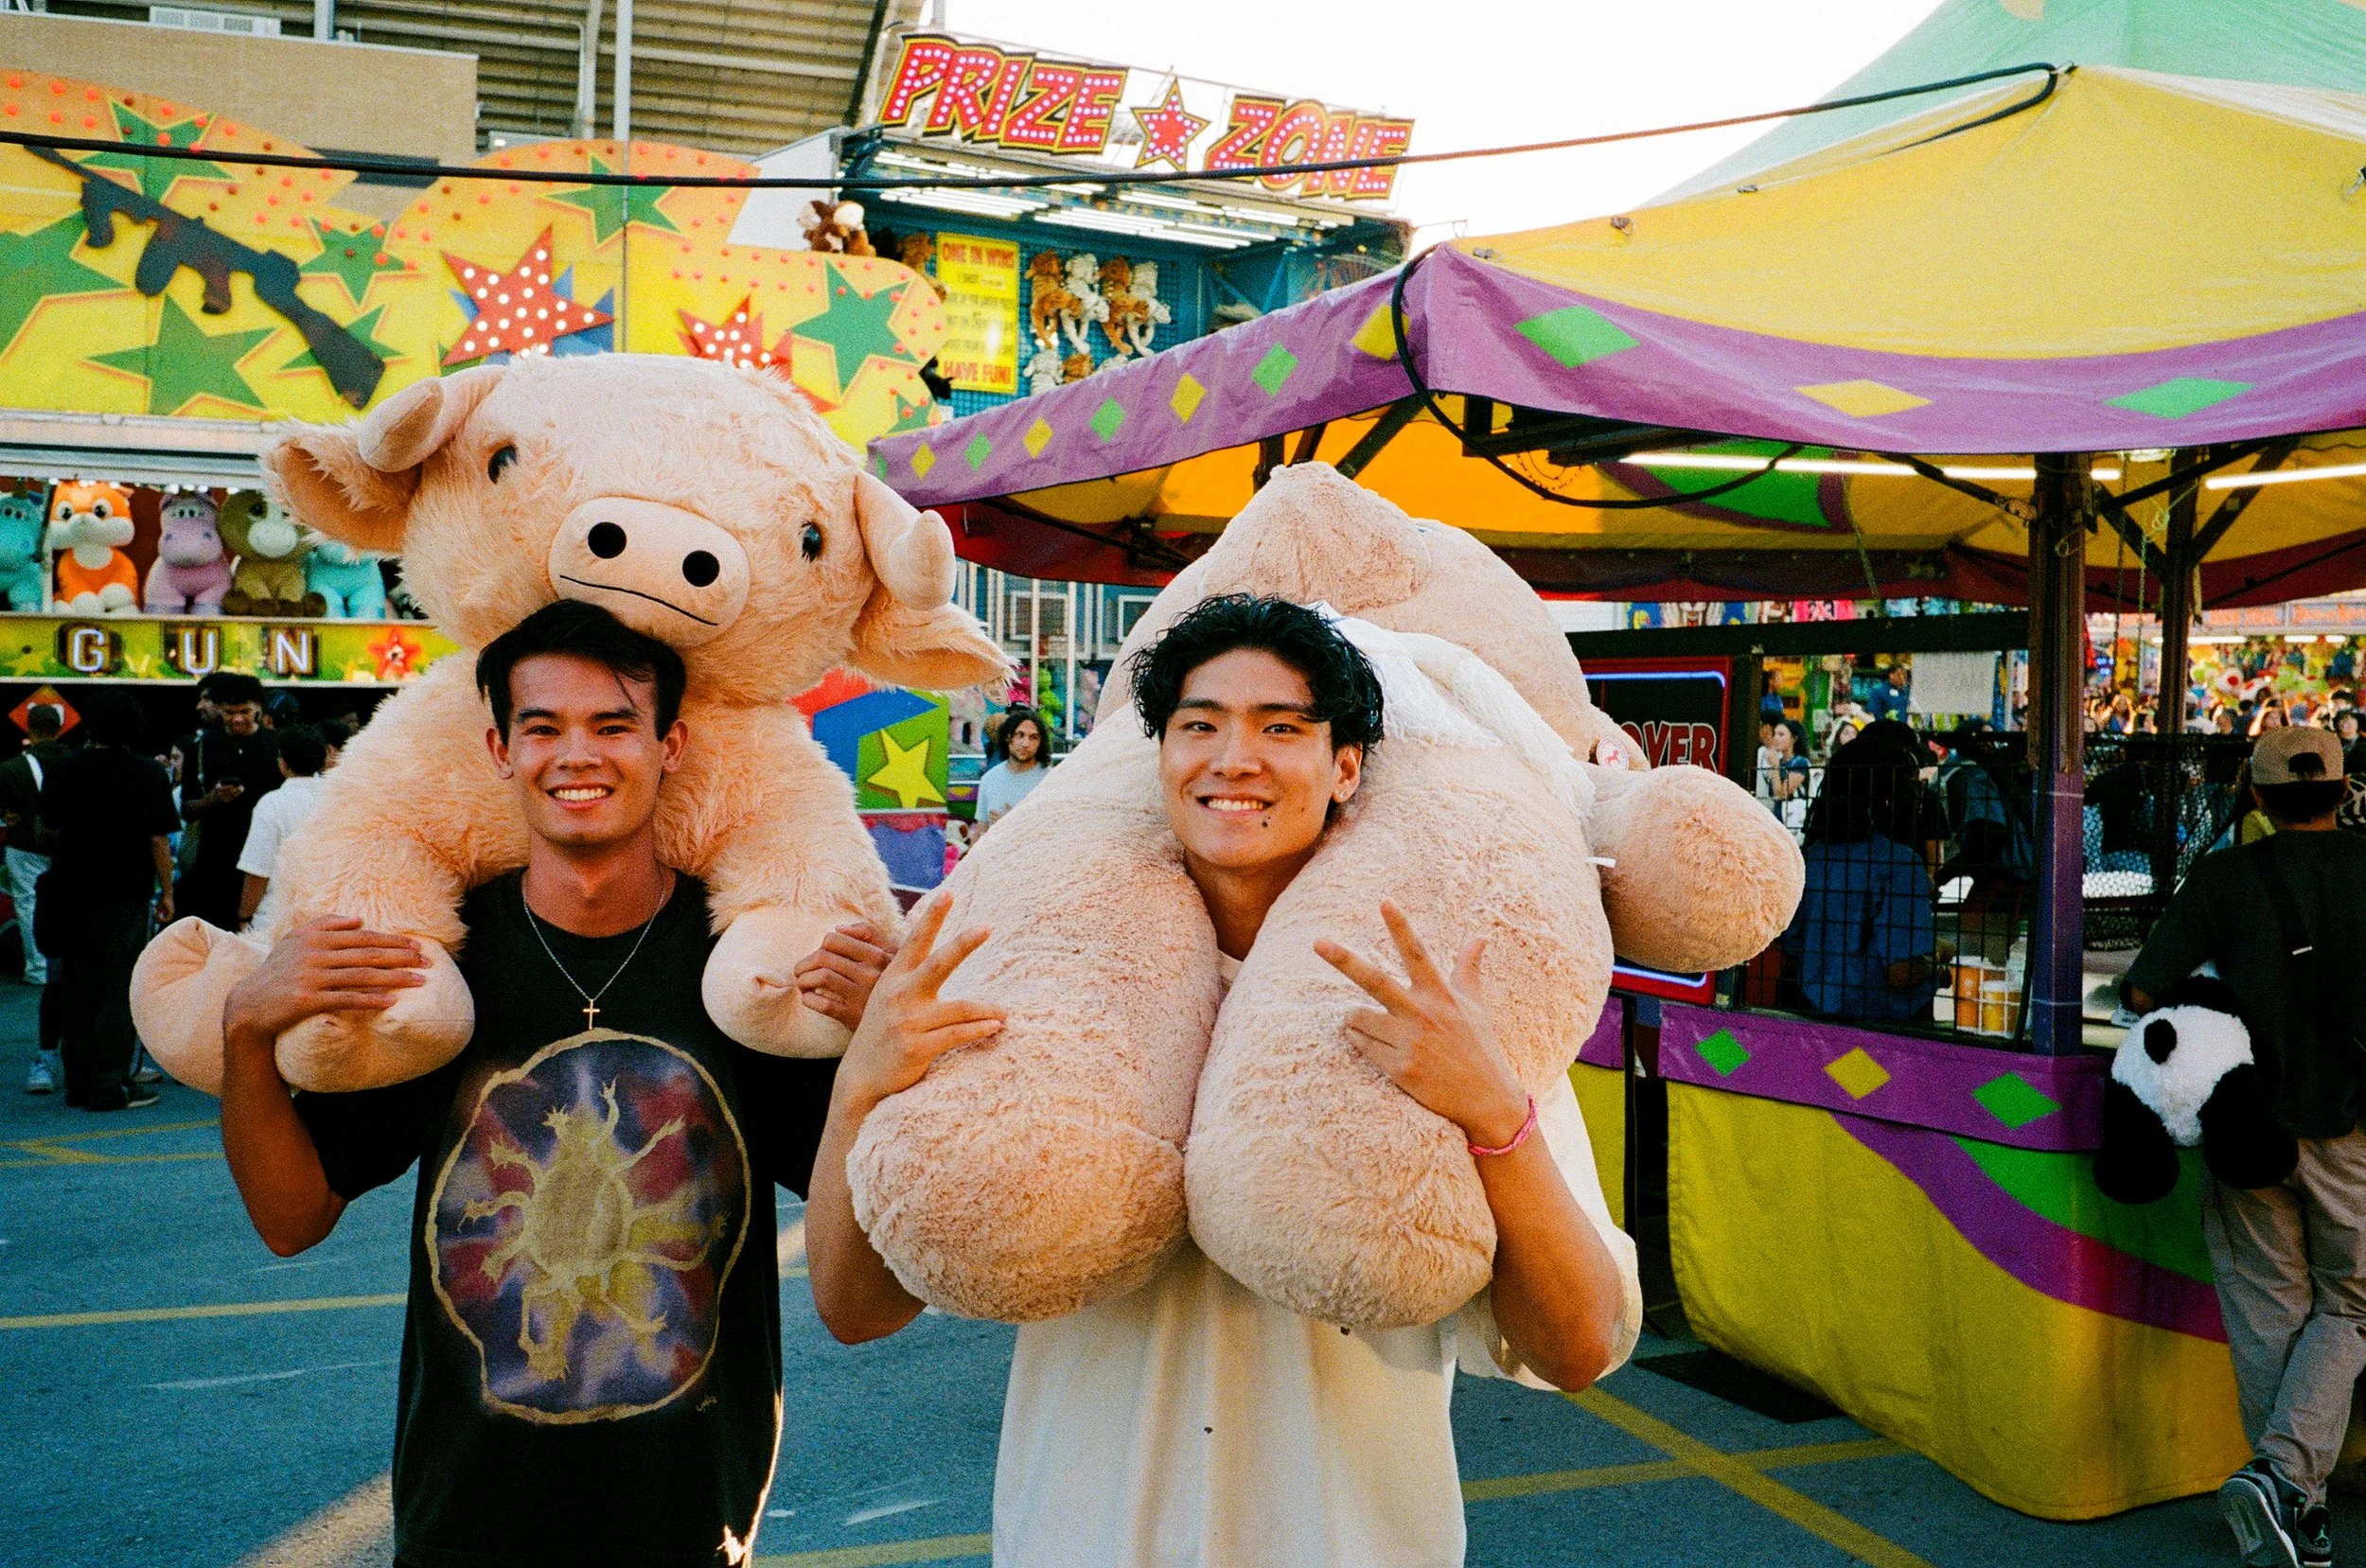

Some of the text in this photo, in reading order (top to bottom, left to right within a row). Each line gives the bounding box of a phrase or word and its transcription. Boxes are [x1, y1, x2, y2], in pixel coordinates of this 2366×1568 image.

[876, 35, 1415, 200] PRIZE ZONE
[943, 361, 979, 382] HAVE
[65, 624, 315, 676] GUN
